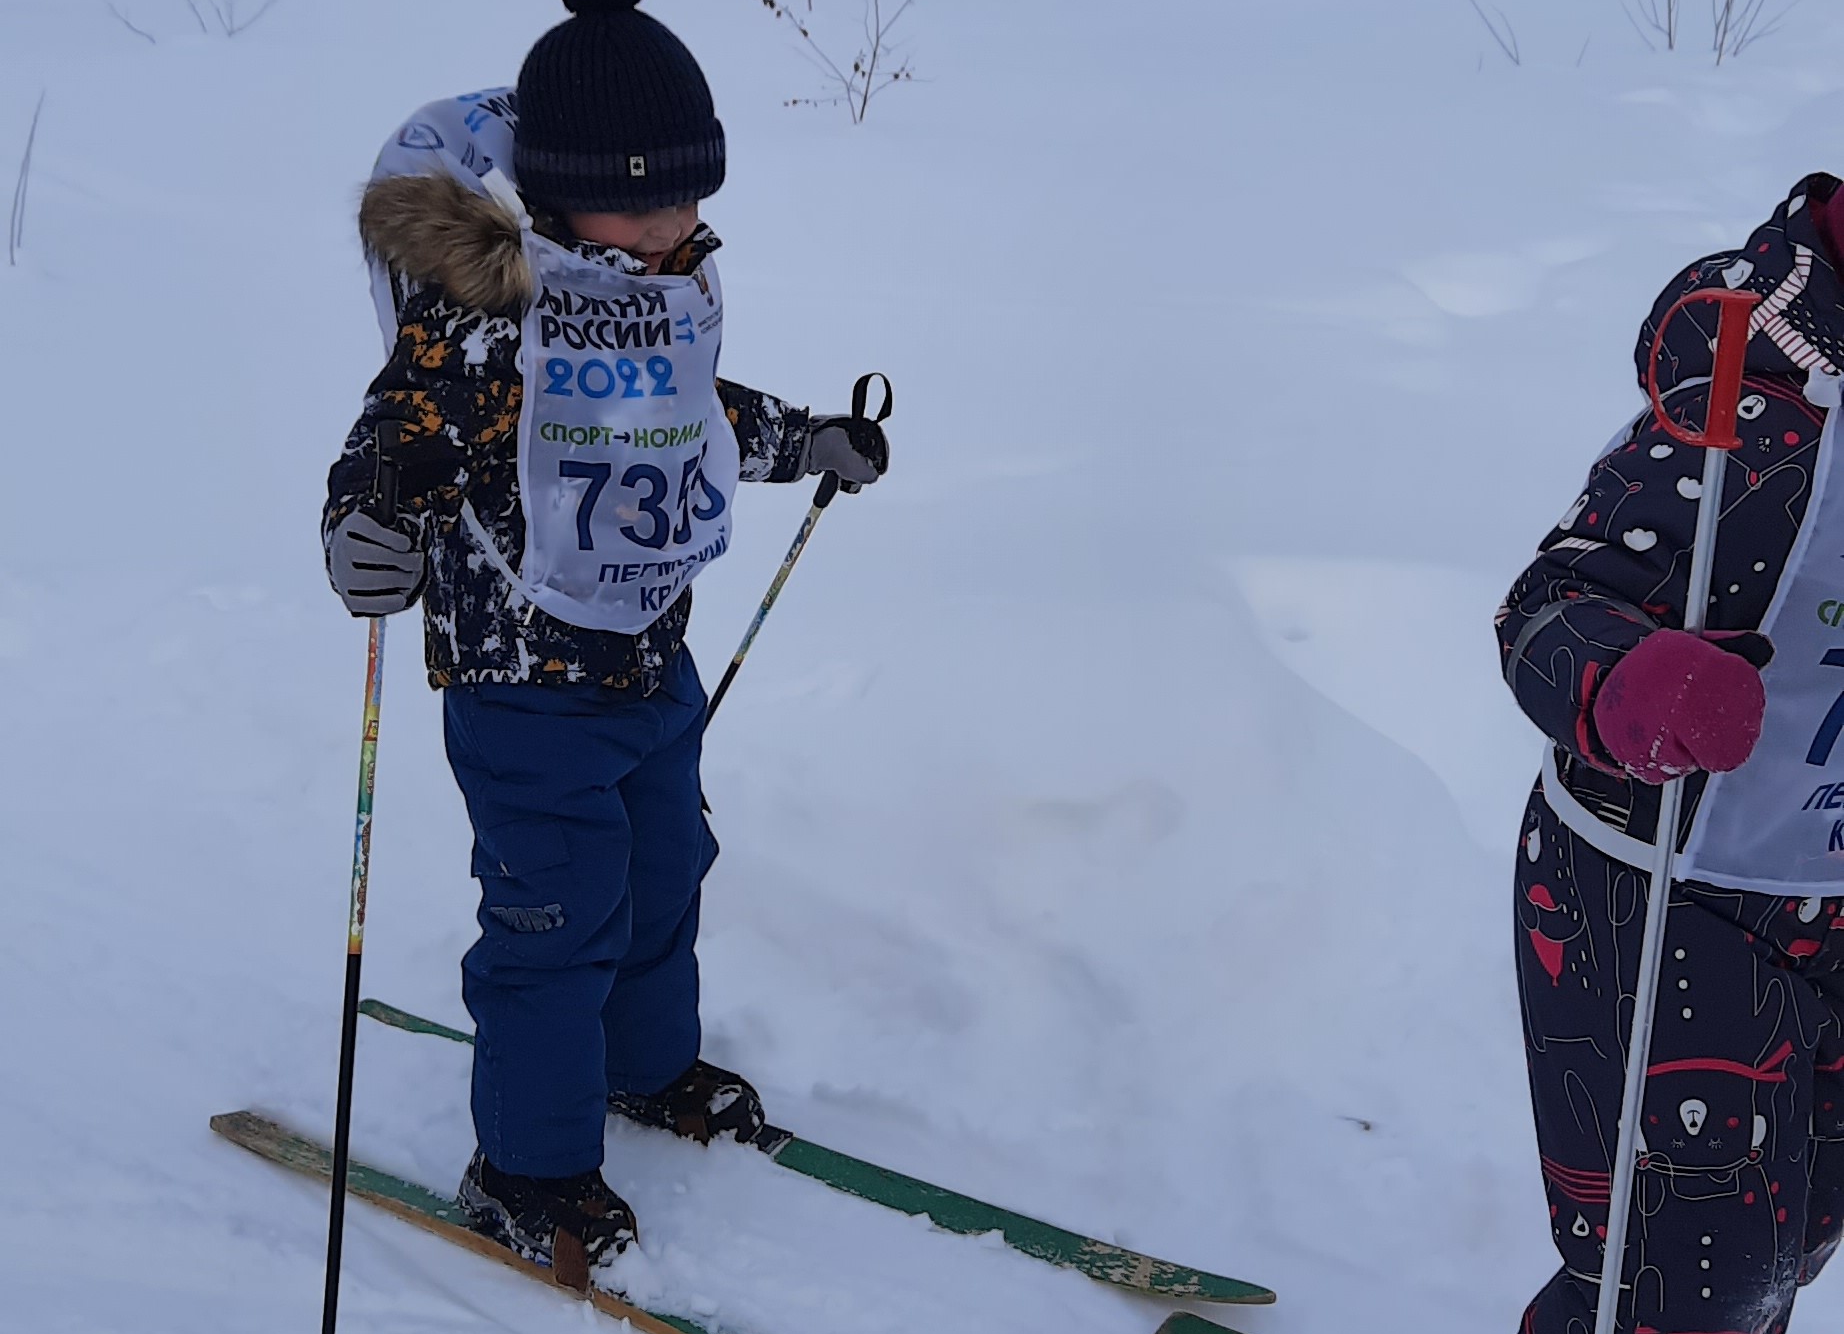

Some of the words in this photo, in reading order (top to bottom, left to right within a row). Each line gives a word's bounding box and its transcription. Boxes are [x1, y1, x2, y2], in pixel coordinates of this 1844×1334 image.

[540, 314, 672, 351] РОССИИ
[543, 354, 678, 399] 2022
[539, 421, 614, 446] СПОРТ
